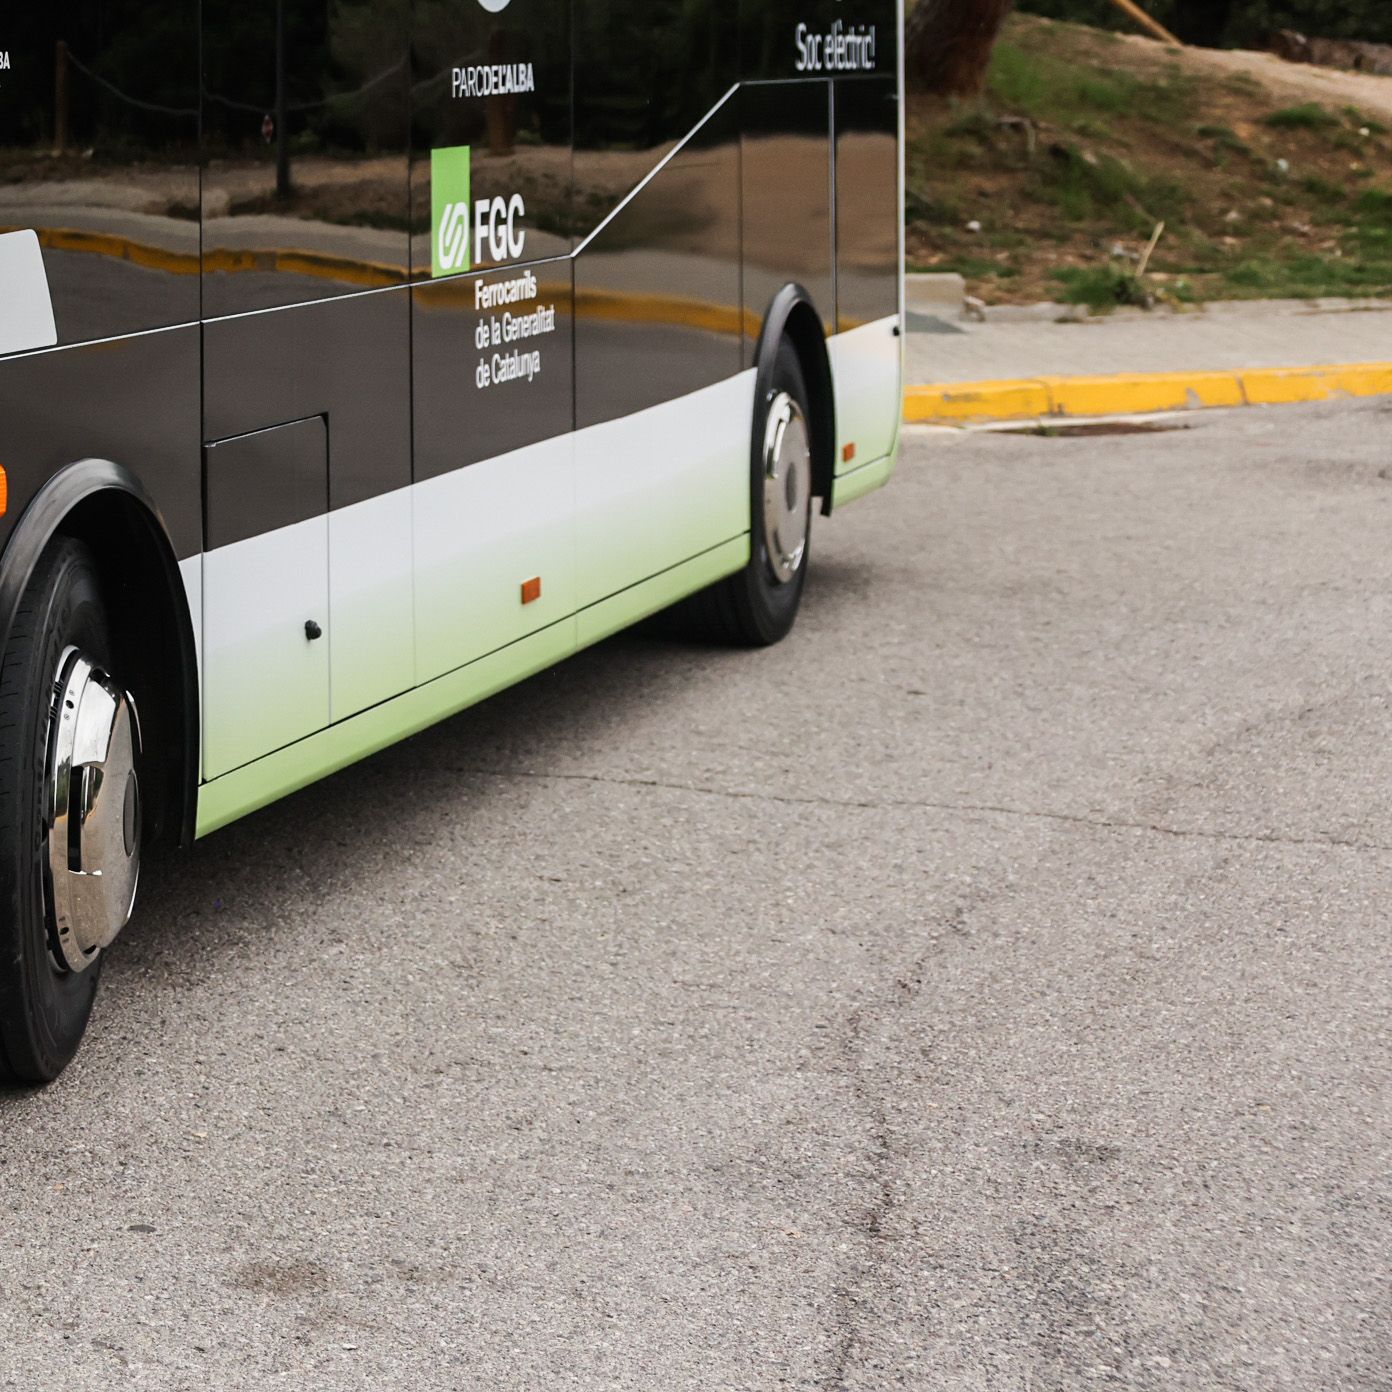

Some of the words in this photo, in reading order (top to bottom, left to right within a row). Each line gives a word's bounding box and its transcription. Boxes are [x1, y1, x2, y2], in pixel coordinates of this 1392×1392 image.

[795, 22, 822, 71] Soc
[474, 193, 525, 265] FGC
[474, 270, 537, 310] Ferrocarrils
[475, 318, 490, 350] de
[491, 316, 502, 345] la
[502, 305, 556, 341] Generalitat
[475, 358, 491, 389] de
[491, 349, 541, 384] Catalunya
